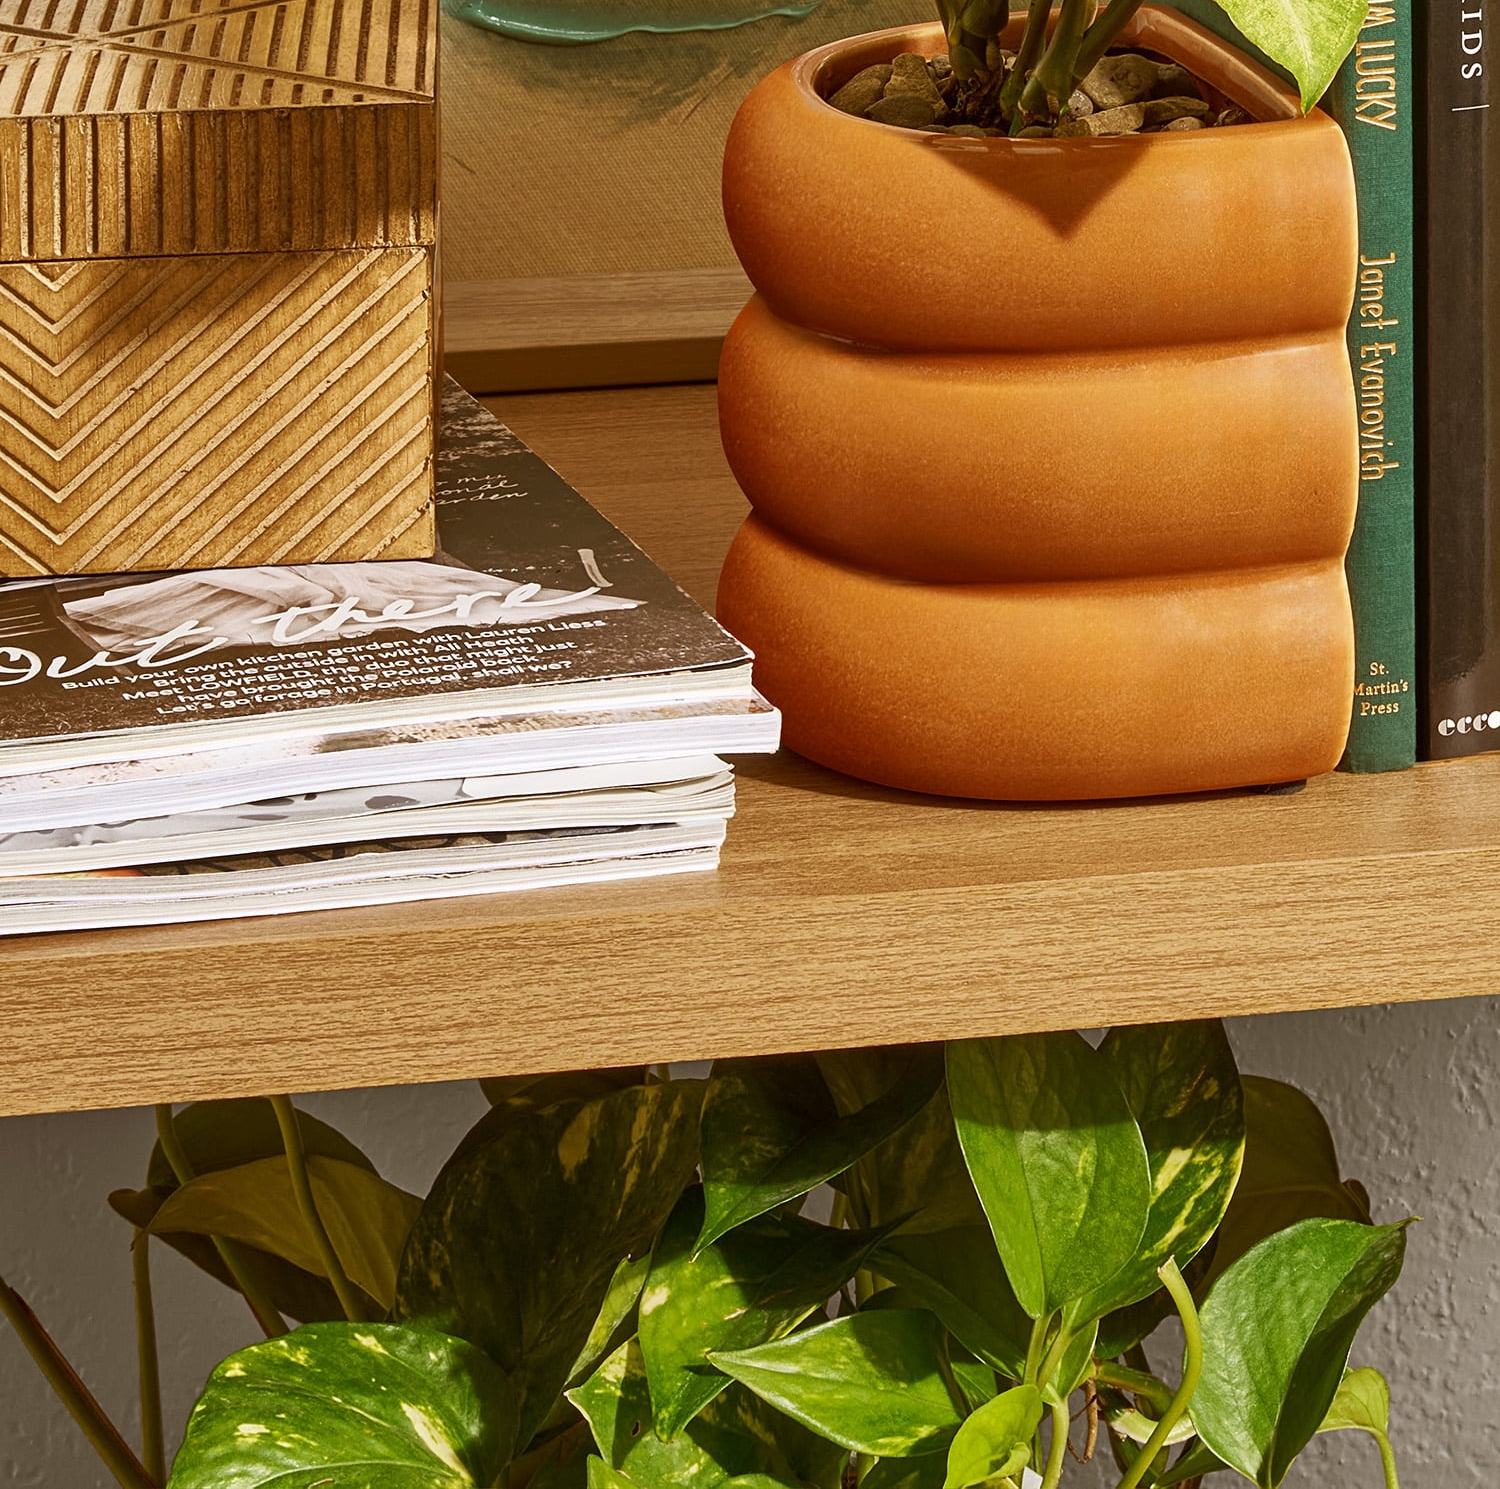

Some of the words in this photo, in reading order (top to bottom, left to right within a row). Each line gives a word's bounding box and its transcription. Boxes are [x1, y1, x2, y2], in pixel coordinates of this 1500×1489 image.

[1355, 40, 1397, 130] LUCKY
[1360, 252, 1398, 329] Janet
[1360, 341, 1400, 482] Evanovich
[61, 676, 120, 690] Build
[124, 669, 177, 683] your
[184, 661, 233, 674] own
[236, 649, 323, 666] kitchen
[327, 640, 408, 656] garden
[413, 632, 462, 646] with
[465, 624, 545, 639] Lauren
[548, 619, 606, 631] Liess
[122, 687, 184, 701] Meet
[187, 670, 319, 692] LOWFIELD,
[321, 665, 360, 676] the
[365, 659, 410, 671] duo
[413, 652, 463, 664] that
[466, 645, 532, 659] might
[535, 640, 578, 654] just
[153, 673, 216, 688] Bring
[220, 667, 258, 678] the
[263, 655, 349, 672] outside
[352, 653, 374, 662] in
[378, 646, 428, 658] with
[434, 641, 461, 653] Ali
[464, 635, 534, 649] Heath
[177, 690, 237, 703] have
[240, 678, 336, 695] brought
[339, 672, 378, 684] the
[381, 660, 478, 679] Polaroid
[1369, 662, 1390, 676] St.
[156, 701, 215, 715] Let's
[220, 697, 250, 710] go
[254, 687, 331, 703] forage
[336, 685, 357, 695] in
[360, 671, 468, 691] Portugal,
[472, 665, 525, 679] shall
[528, 659, 573, 672] we?
[1354, 679, 1409, 696] Martin's
[1361, 701, 1399, 716] Press
